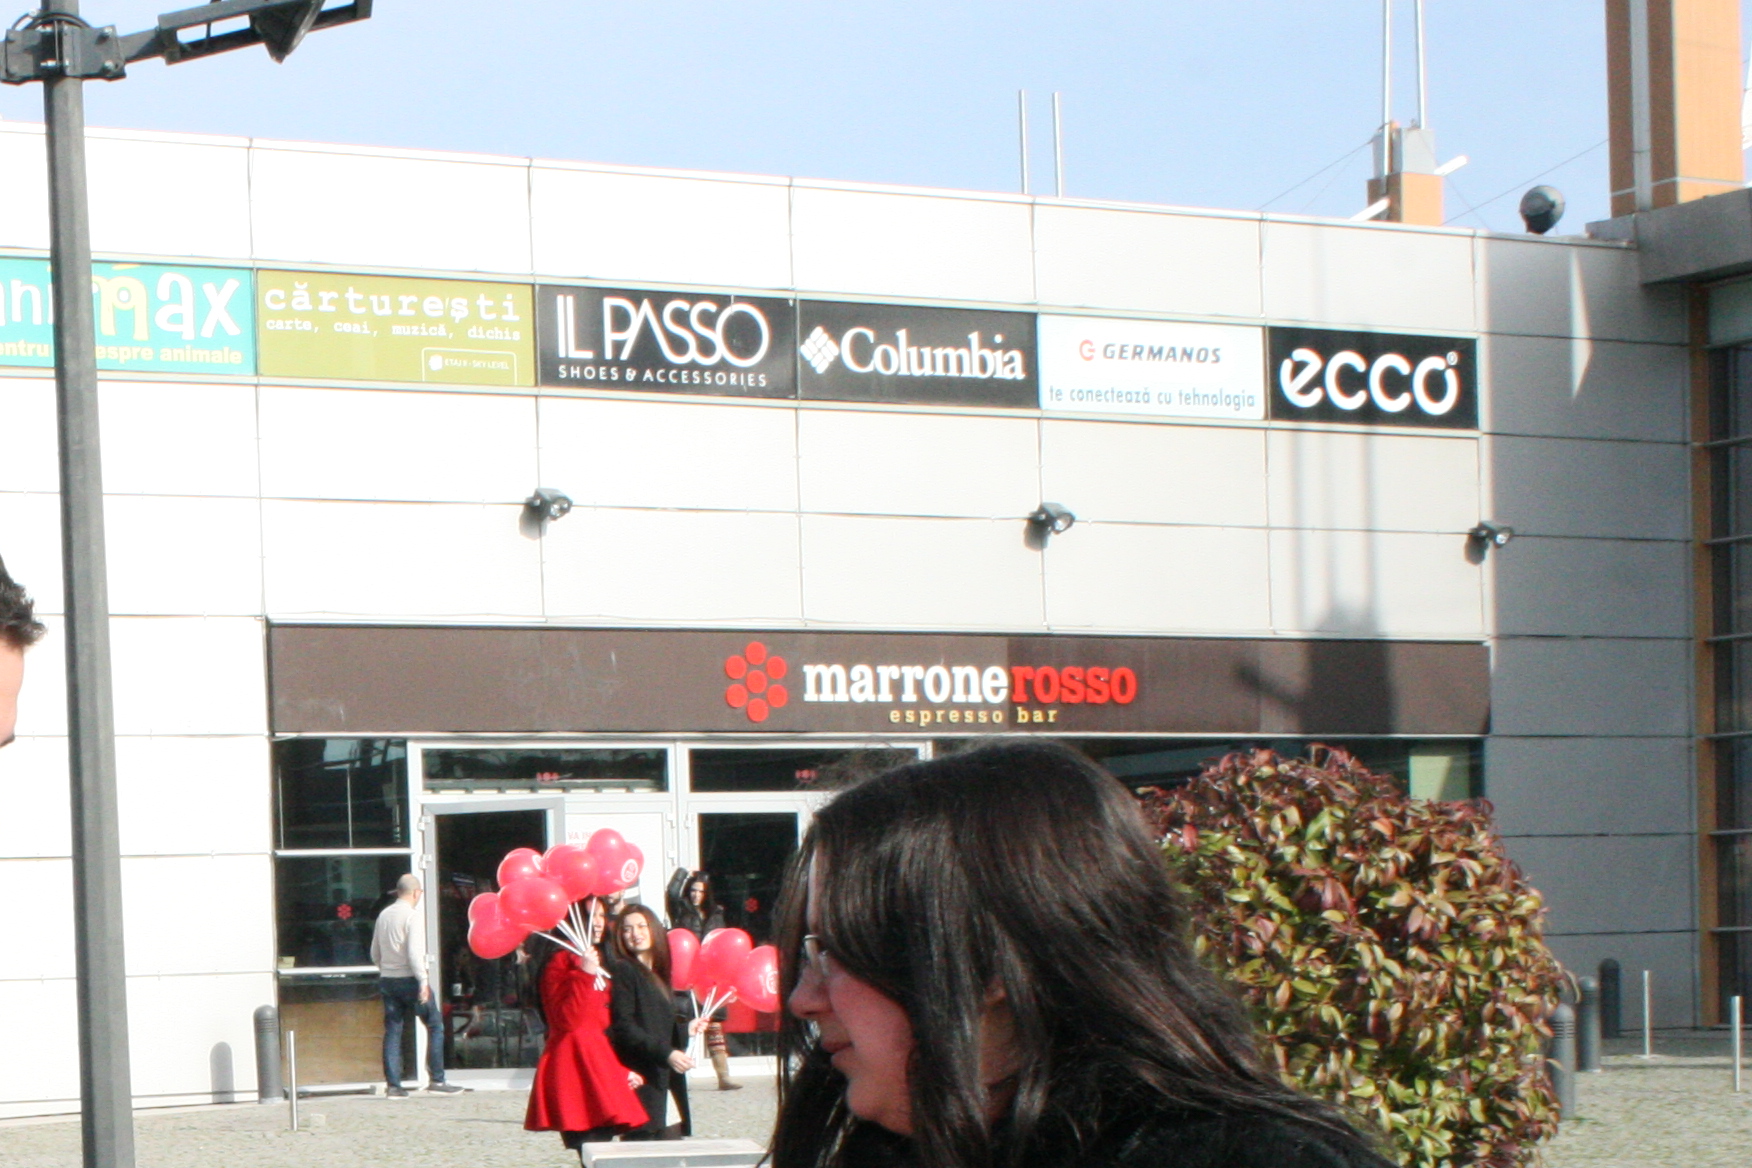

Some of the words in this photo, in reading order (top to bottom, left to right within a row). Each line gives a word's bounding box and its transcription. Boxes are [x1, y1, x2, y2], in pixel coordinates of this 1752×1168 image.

[467, 325, 521, 341] dichis
[556, 294, 594, 359] IL
[603, 298, 770, 368] PASSO
[94, 344, 154, 364] espre
[159, 345, 243, 365] animale
[840, 327, 1026, 380] Columbia
[1101, 342, 1222, 364] GERMANOS
[558, 364, 620, 382] SHOES
[624, 366, 635, 381] &
[642, 367, 767, 387] ACCESSORIES
[1279, 347, 1459, 416] ecco
[1048, 385, 1063, 402] te
[1069, 386, 1151, 404] conectează
[1156, 392, 1172, 406] cu
[1178, 387, 1256, 412] tehnologia
[889, 708, 1004, 727] espresso
[1016, 707, 1058, 724] bar
